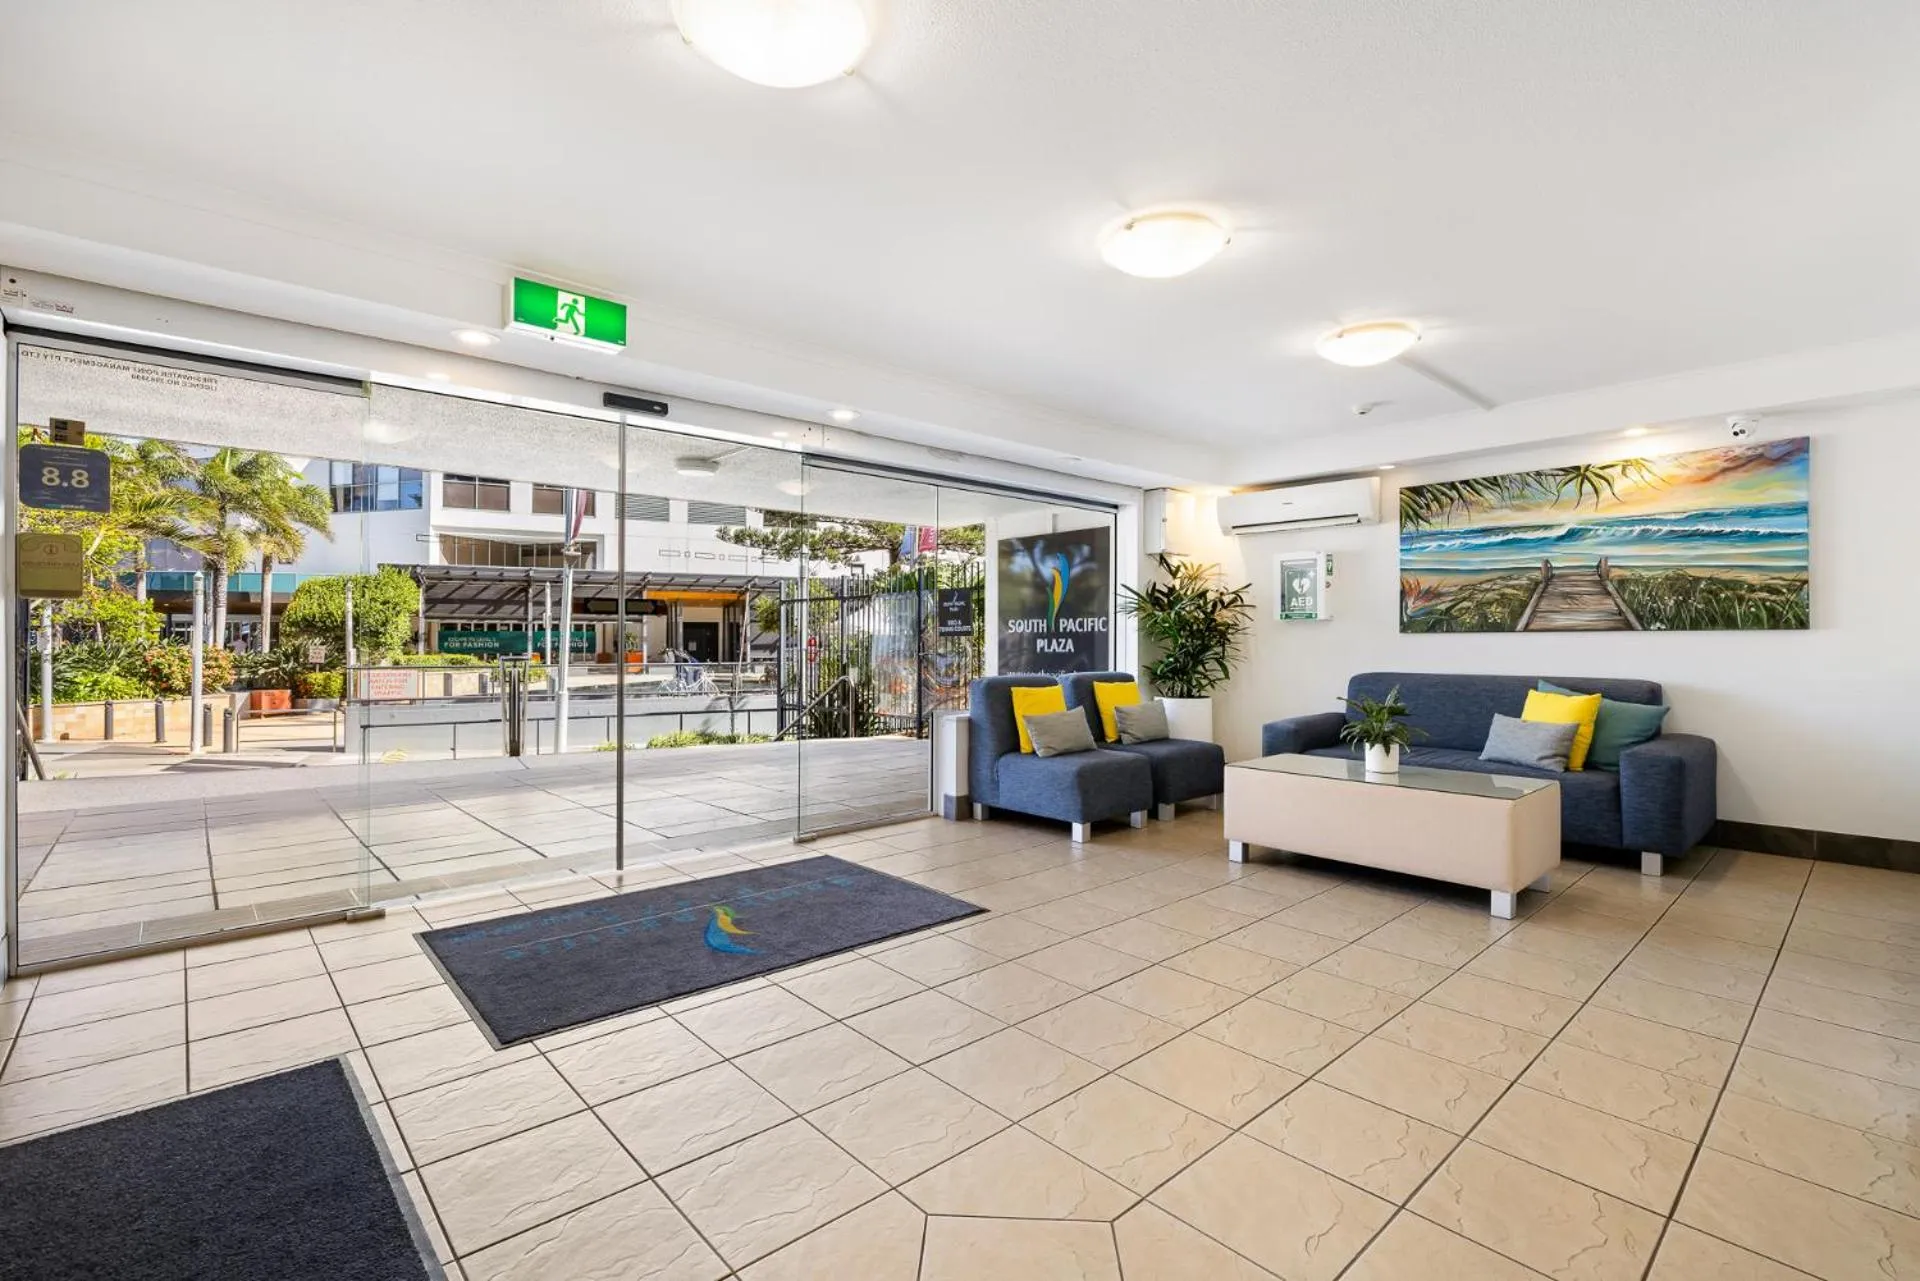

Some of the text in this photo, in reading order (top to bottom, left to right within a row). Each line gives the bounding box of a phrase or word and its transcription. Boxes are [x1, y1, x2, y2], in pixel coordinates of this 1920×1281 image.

[41, 465, 90, 489] 8.8
[1290, 596, 1313, 608] AED
[1008, 617, 1108, 634] SOUTH PACIFIC
[463, 641, 500, 649] FASHION
[1036, 638, 1075, 653] PLAZA
